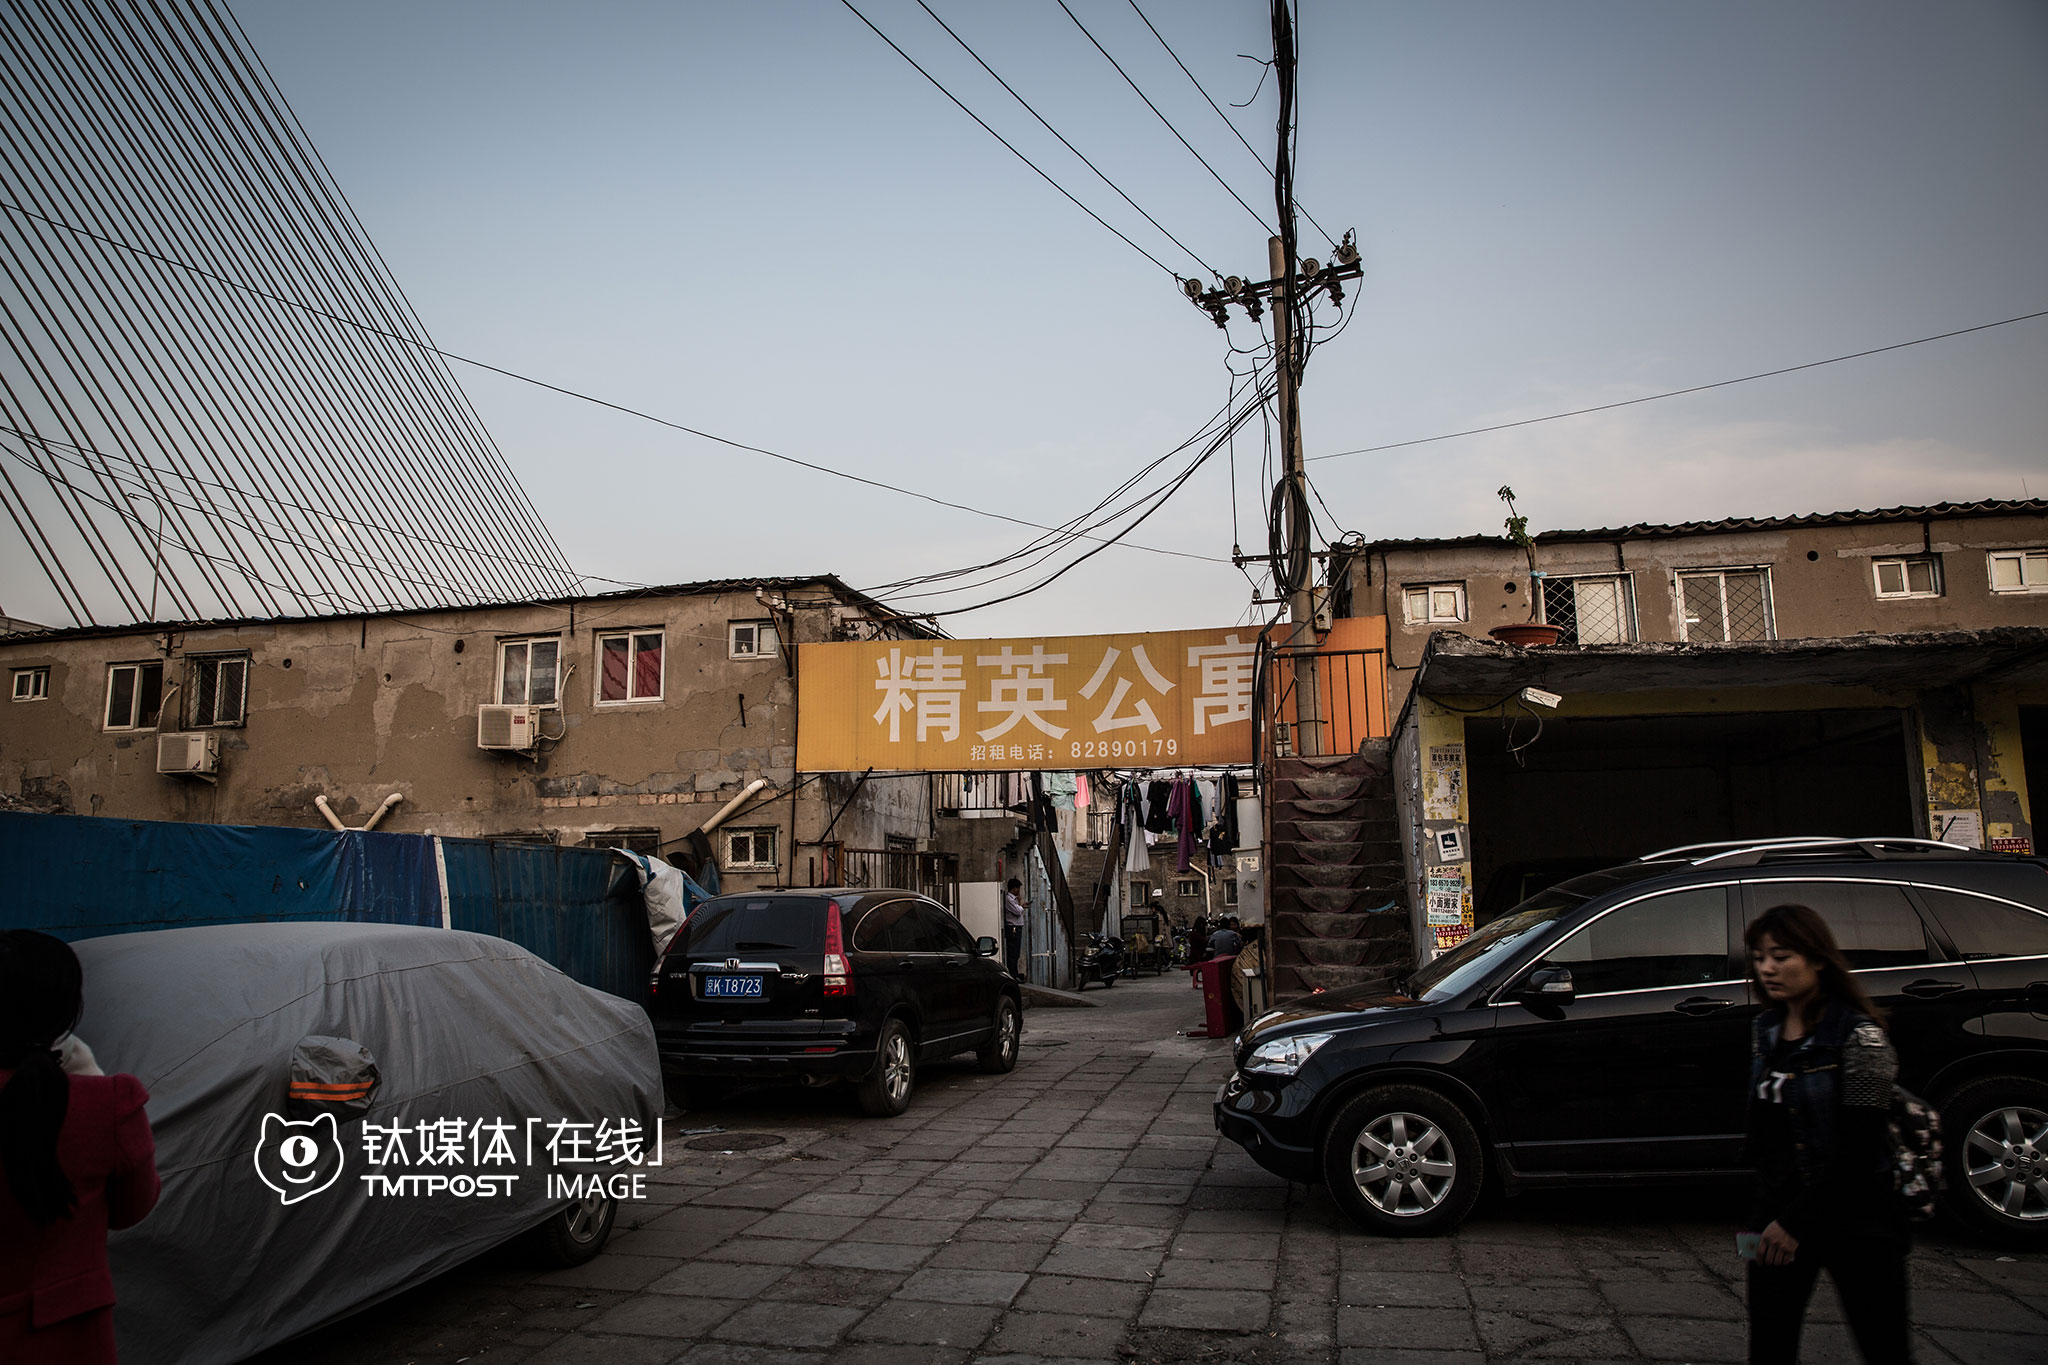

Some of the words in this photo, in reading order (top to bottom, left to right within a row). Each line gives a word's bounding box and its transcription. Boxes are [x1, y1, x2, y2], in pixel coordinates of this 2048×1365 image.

[873, 634, 1276, 743] 精英公寓
[1070, 738, 1179, 759] 82890179
[1429, 896, 1459, 910] 小面搬家
